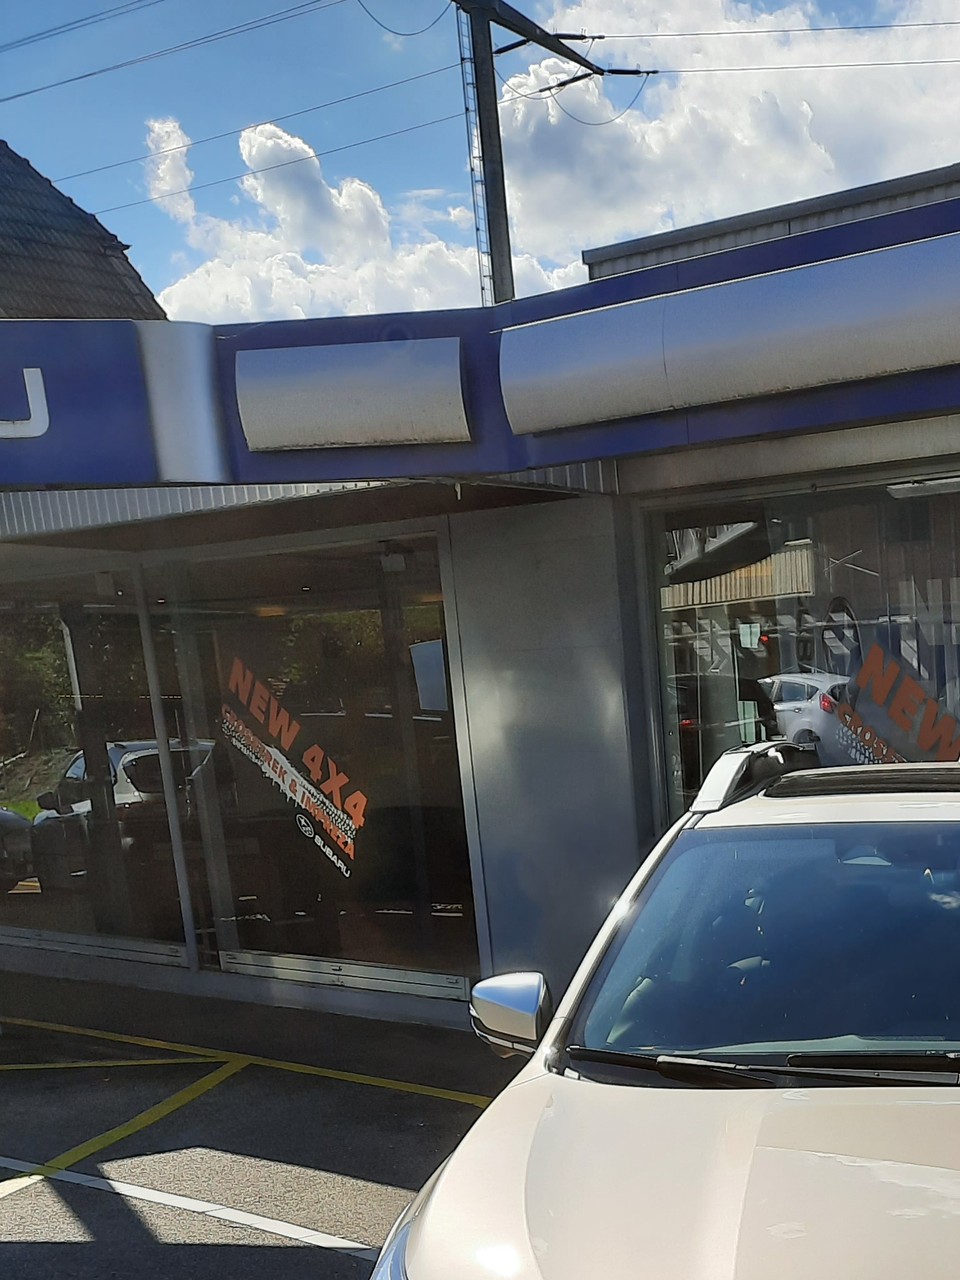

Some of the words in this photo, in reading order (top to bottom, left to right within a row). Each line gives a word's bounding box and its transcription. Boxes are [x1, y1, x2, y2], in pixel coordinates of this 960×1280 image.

[228, 657, 301, 751] NEW
[302, 743, 369, 829] 4X4
[314, 834, 351, 878] SUBARU
